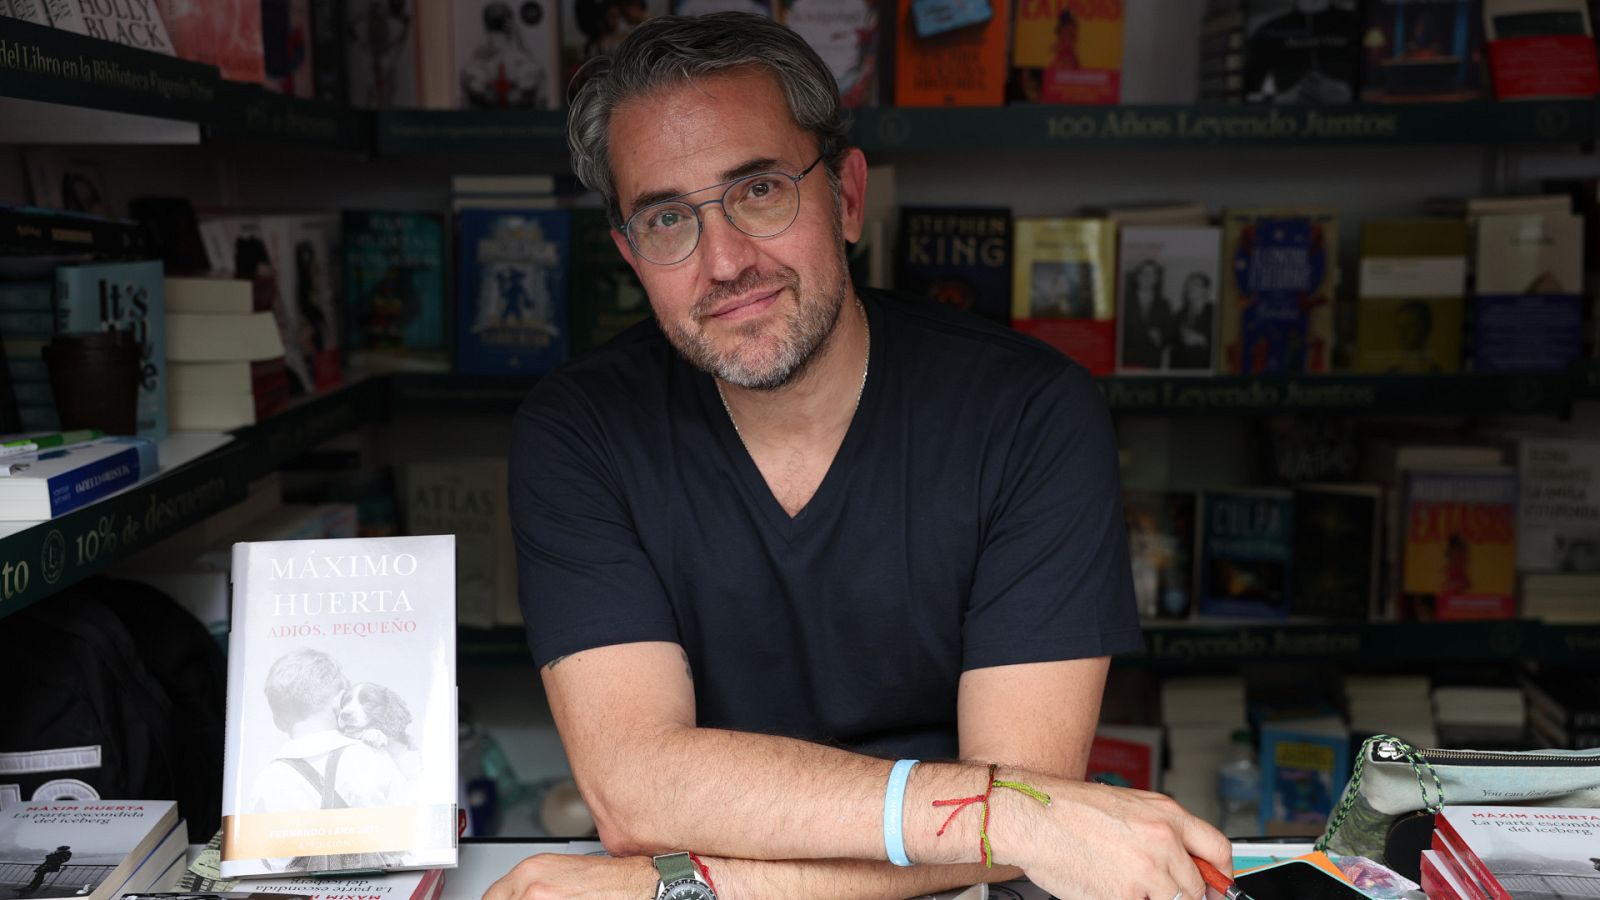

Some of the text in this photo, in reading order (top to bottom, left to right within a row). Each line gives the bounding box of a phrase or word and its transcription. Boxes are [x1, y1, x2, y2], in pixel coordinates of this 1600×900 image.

[77, 0, 155, 22] HOLLY
[82, 16, 167, 48] BLACK
[23, 45, 61, 77] Libro
[63, 60, 80, 82] en
[80, 55, 91, 83] la
[93, 60, 149, 91] Biblioteca
[1048, 109, 1398, 143] 100 Años Leyendo Juntos
[908, 214, 1006, 235] STEPHEN
[909, 236, 1006, 267] KING
[99, 278, 148, 321] It's
[1162, 379, 1279, 414] Leyendo
[1286, 379, 1377, 407] Juntos
[75, 512, 117, 566] 10%
[122, 514, 140, 545] de
[144, 476, 225, 533] descuento
[269, 550, 418, 580] MÁXIMO
[271, 589, 416, 617] HUERTA
[267, 618, 417, 639] ADIÓS, PEQUEÑO
[1153, 629, 1361, 664] Leyendo Juntos
[1482, 789, 1503, 797] You
[60, 817, 110, 825] iceberg
[1535, 827, 1593, 836] iceberg
[255, 885, 329, 893] escondida
